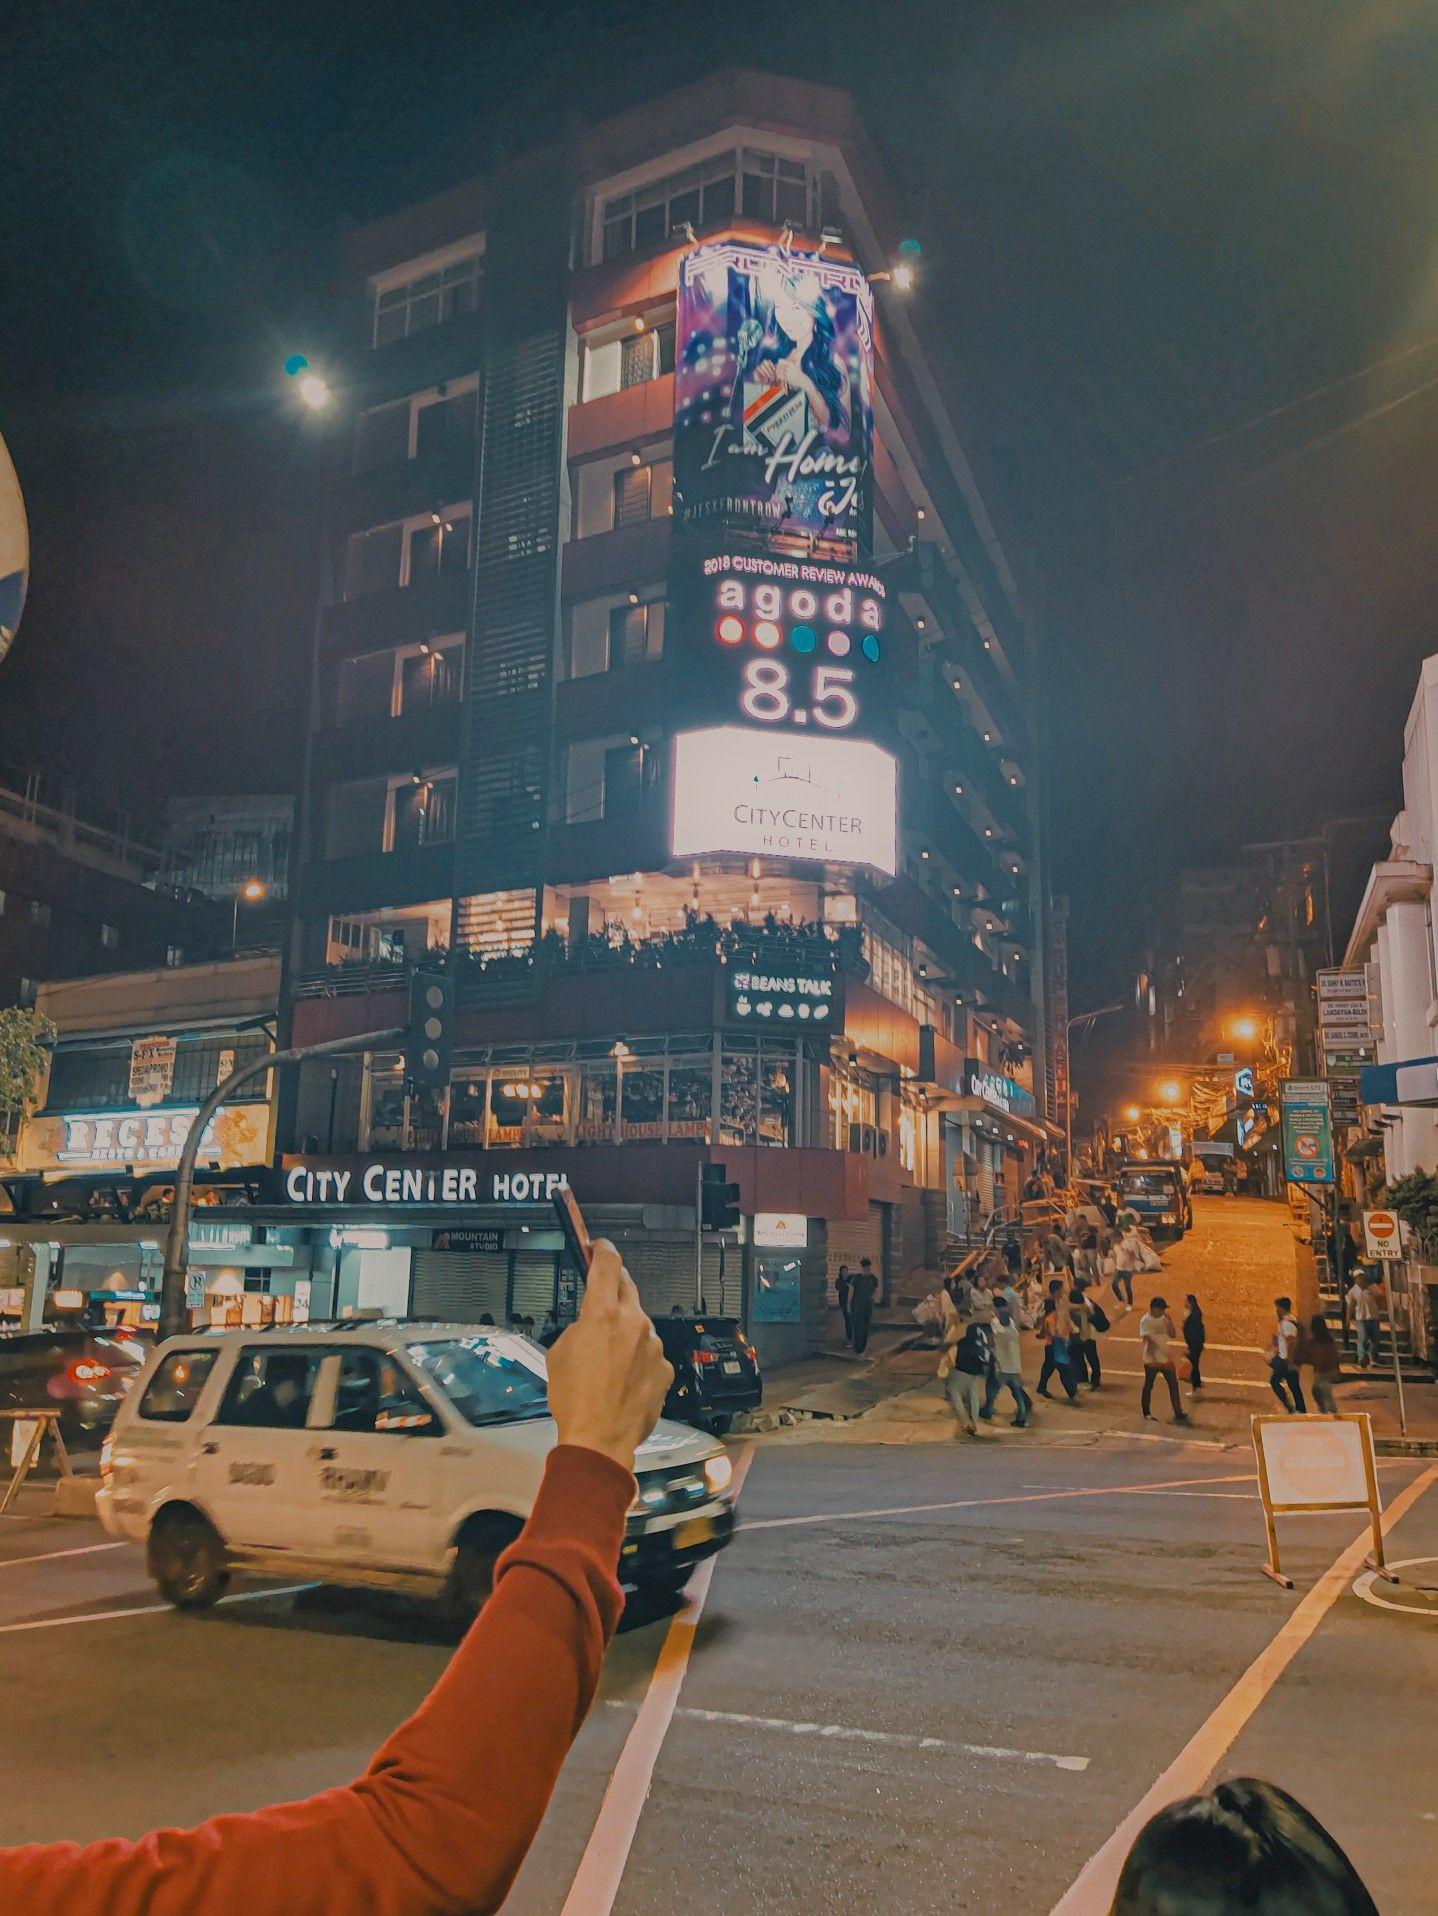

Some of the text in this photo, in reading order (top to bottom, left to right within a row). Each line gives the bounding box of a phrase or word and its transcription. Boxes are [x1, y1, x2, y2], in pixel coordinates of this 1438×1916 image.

[732, 556, 799, 580] CUSTOMER
[801, 566, 846, 586] REVIEW
[718, 579, 880, 632] agoda
[742, 658, 858, 728] 8.5
[763, 835, 833, 852] HOTEL
[286, 1165, 351, 1202] CITY
[362, 1163, 478, 1201] CENTER
[451, 1231, 499, 1242] MOUNTAIN
[1377, 1240, 1389, 1248] NO
